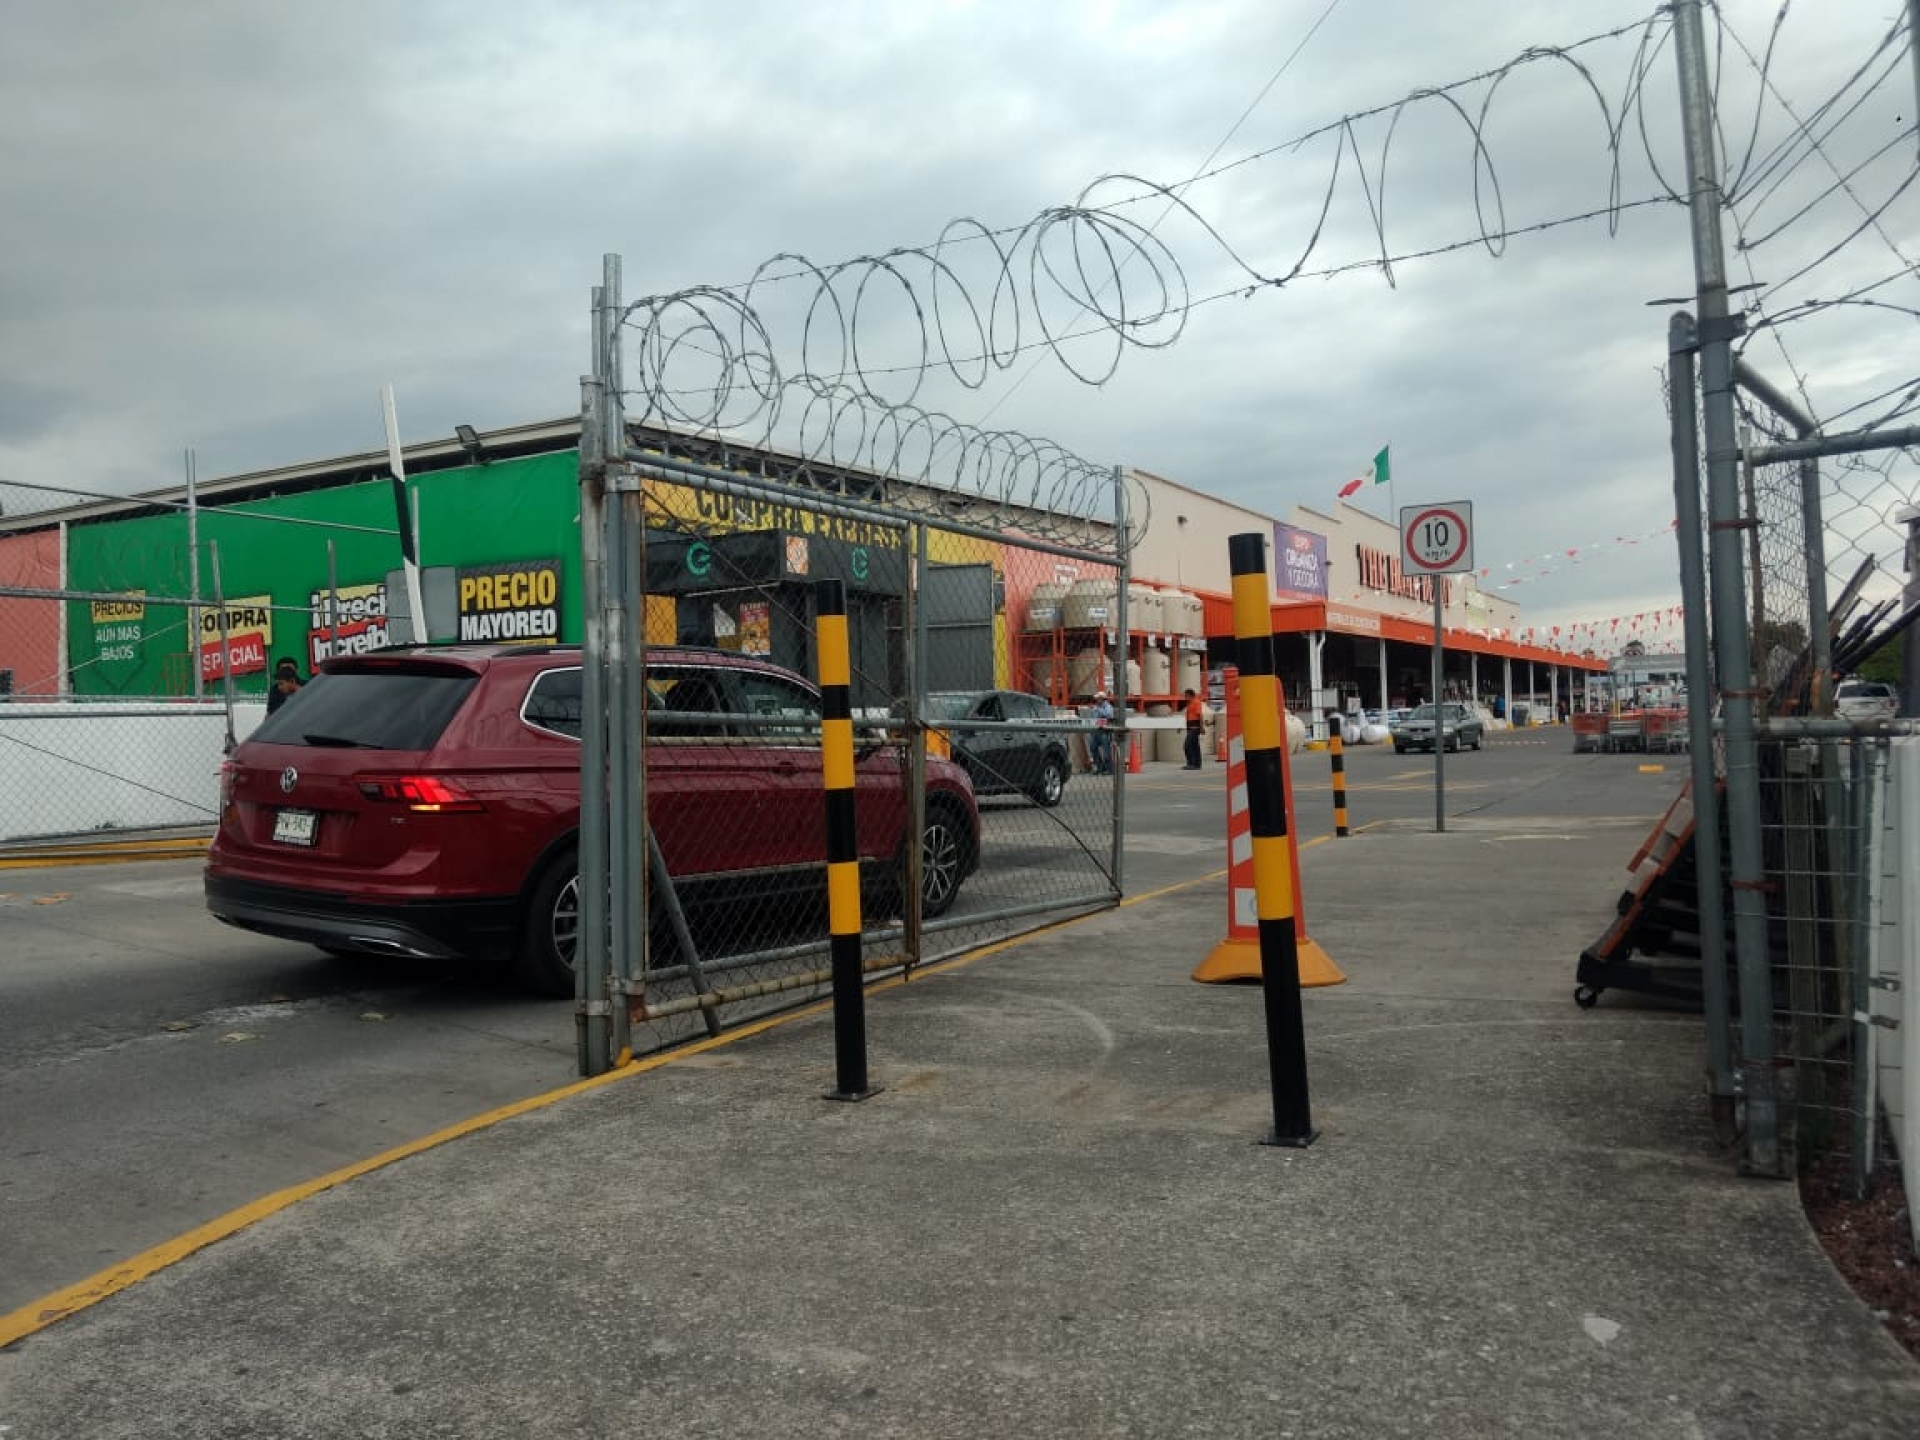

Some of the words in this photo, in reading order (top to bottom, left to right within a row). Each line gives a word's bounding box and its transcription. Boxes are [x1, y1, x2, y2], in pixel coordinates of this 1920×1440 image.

[1424, 521, 1449, 548] 10
[461, 569, 556, 611] PRECIO
[94, 602, 142, 617] PRECIOS
[199, 608, 268, 632] OMPRA
[461, 609, 558, 641] MAYOREO
[202, 644, 264, 671] SPCIAL
